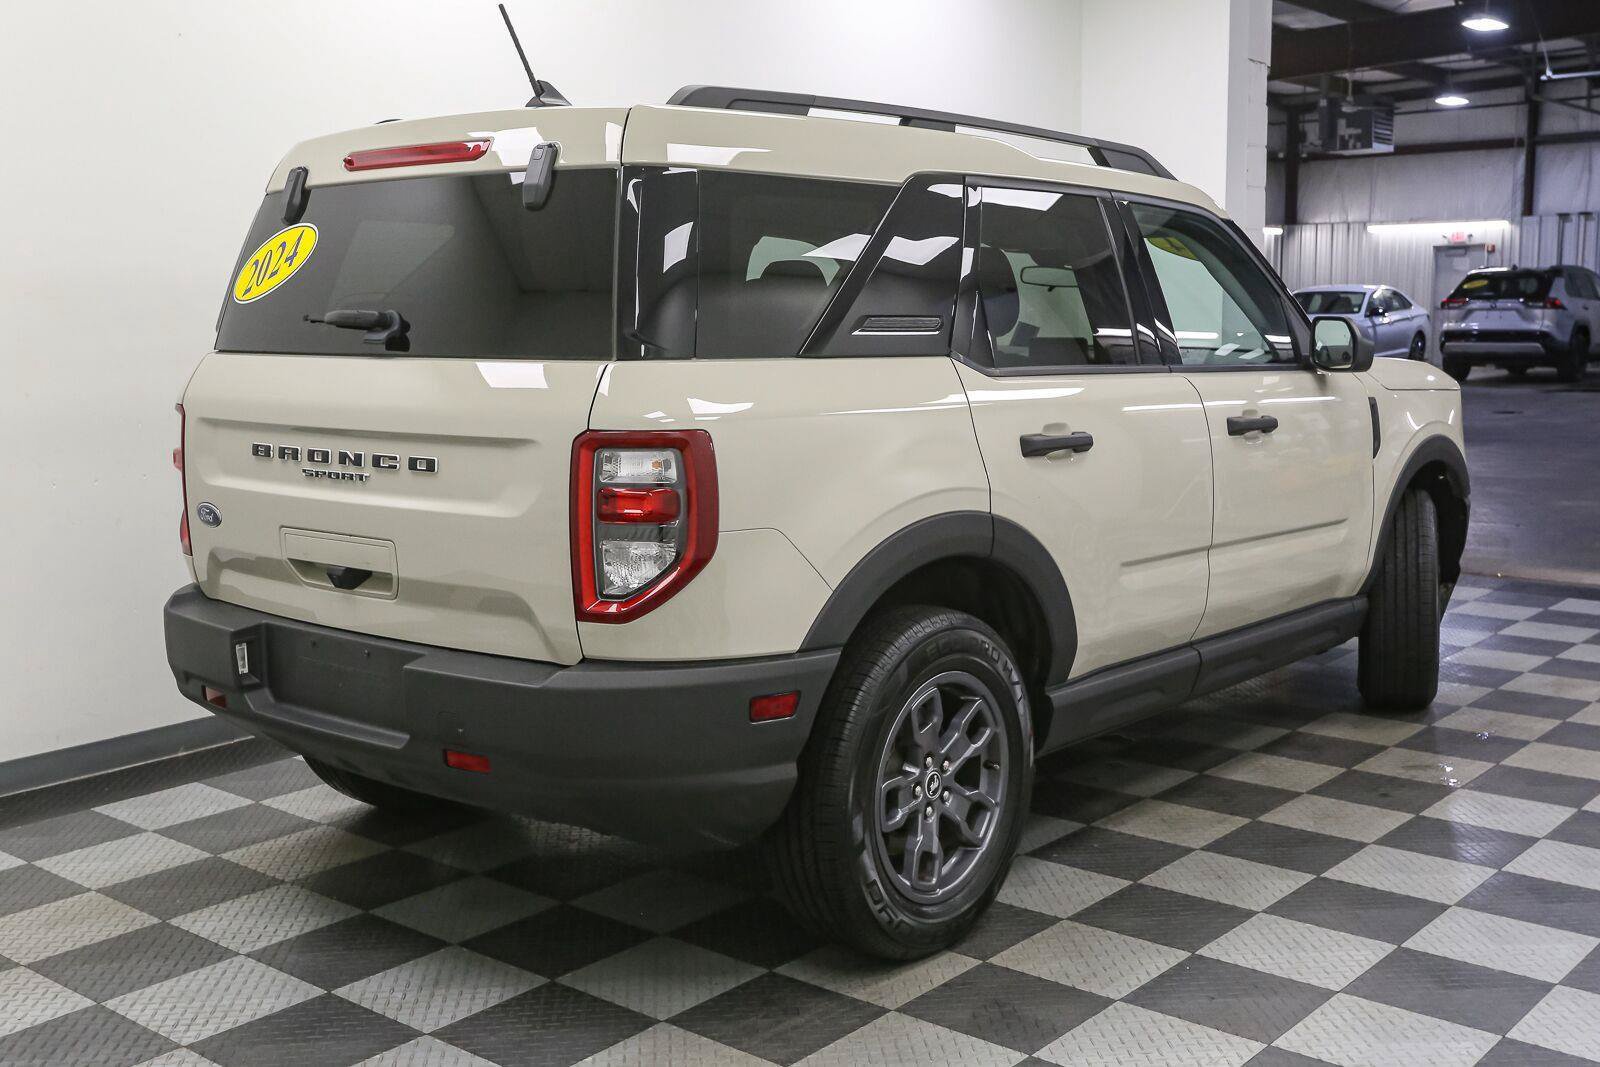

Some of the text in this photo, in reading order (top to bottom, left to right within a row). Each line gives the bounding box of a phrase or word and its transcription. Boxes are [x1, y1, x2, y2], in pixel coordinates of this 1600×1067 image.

[241, 229, 305, 298] 2024
[251, 442, 439, 473] BRONCO
[302, 468, 370, 482] SPORT
